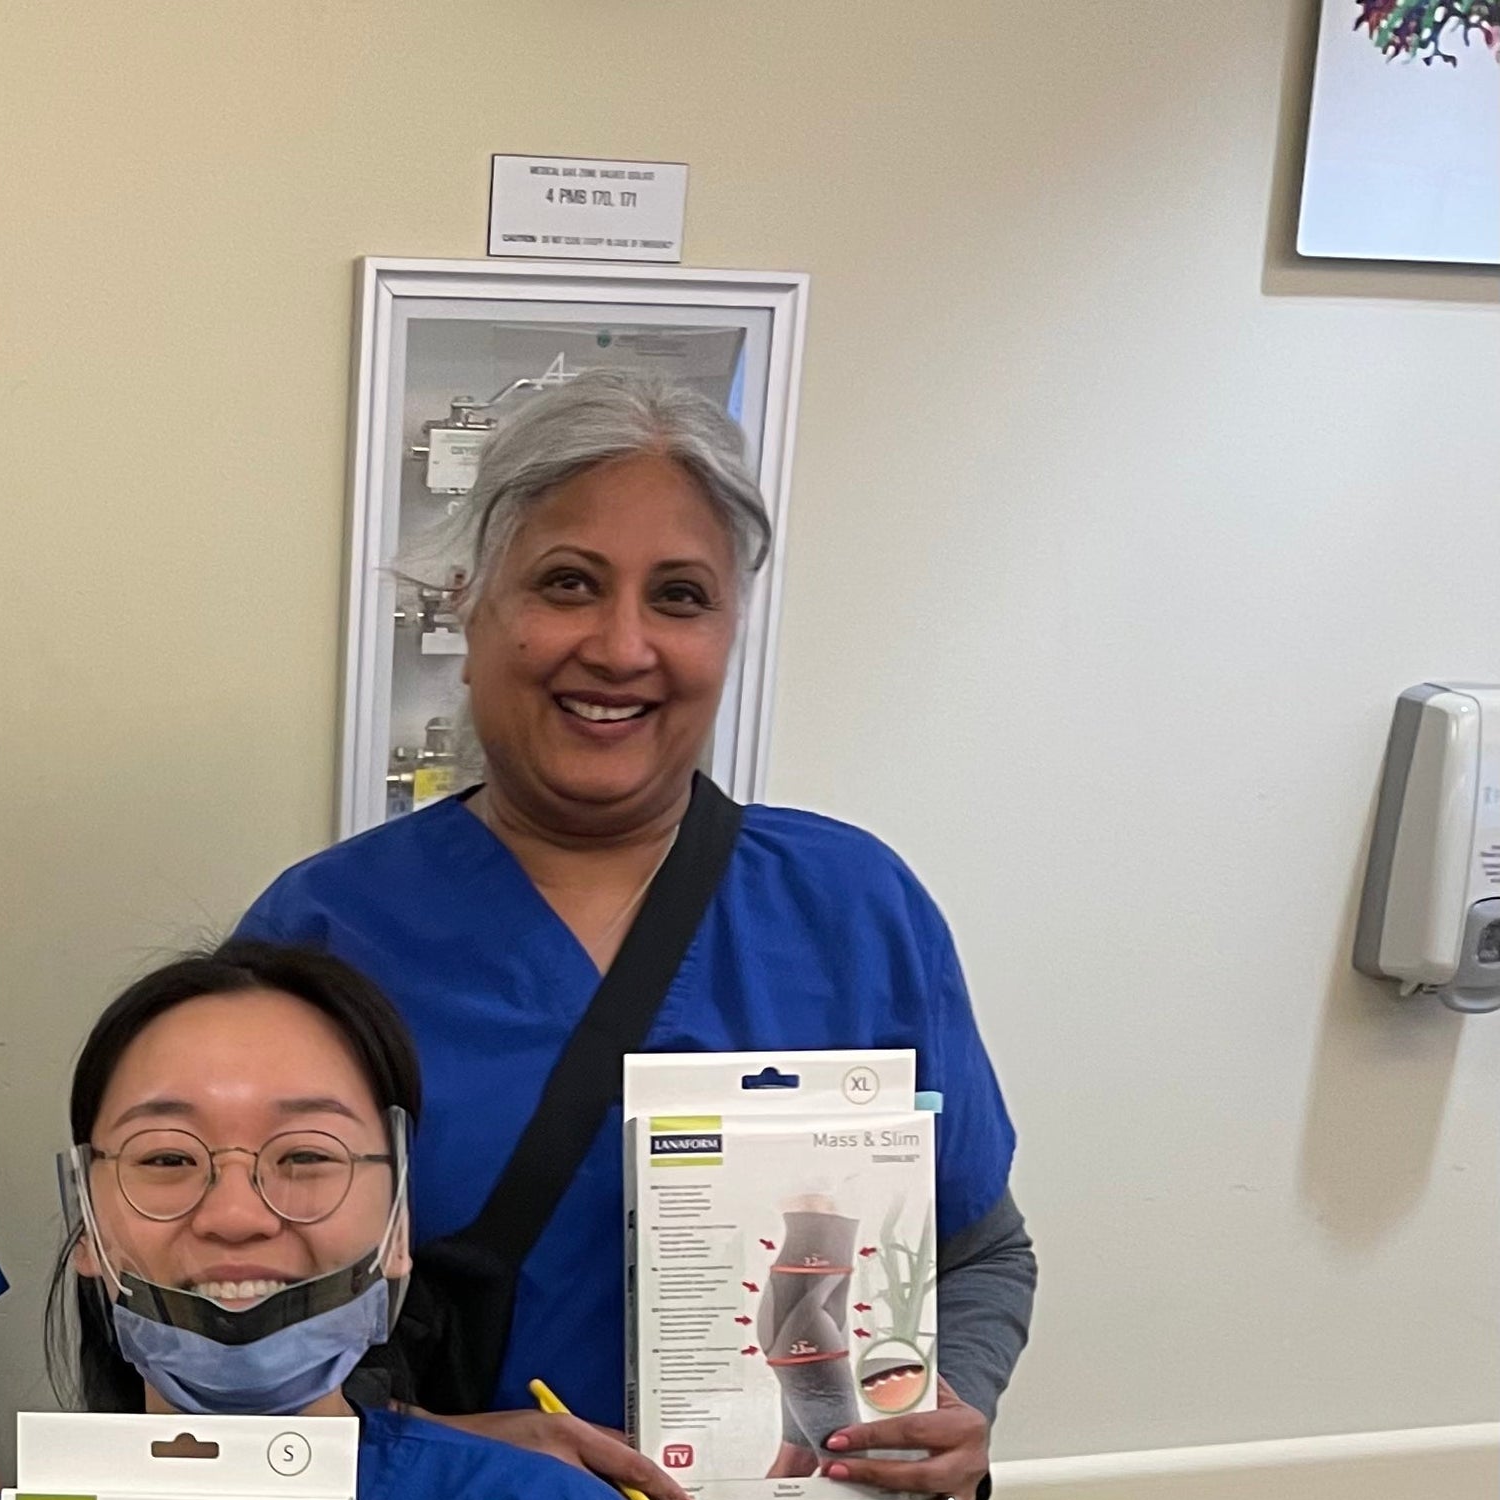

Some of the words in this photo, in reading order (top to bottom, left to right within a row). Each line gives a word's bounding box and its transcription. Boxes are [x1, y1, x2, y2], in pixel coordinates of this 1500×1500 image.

[851, 1076, 871, 1091] XL
[654, 1138, 719, 1150] LANAFORM
[813, 1131, 858, 1147] Mass
[863, 1131, 875, 1147] &
[881, 1130, 920, 1147] Slim
[283, 1445, 294, 1462] S
[667, 1452, 689, 1465] TV
